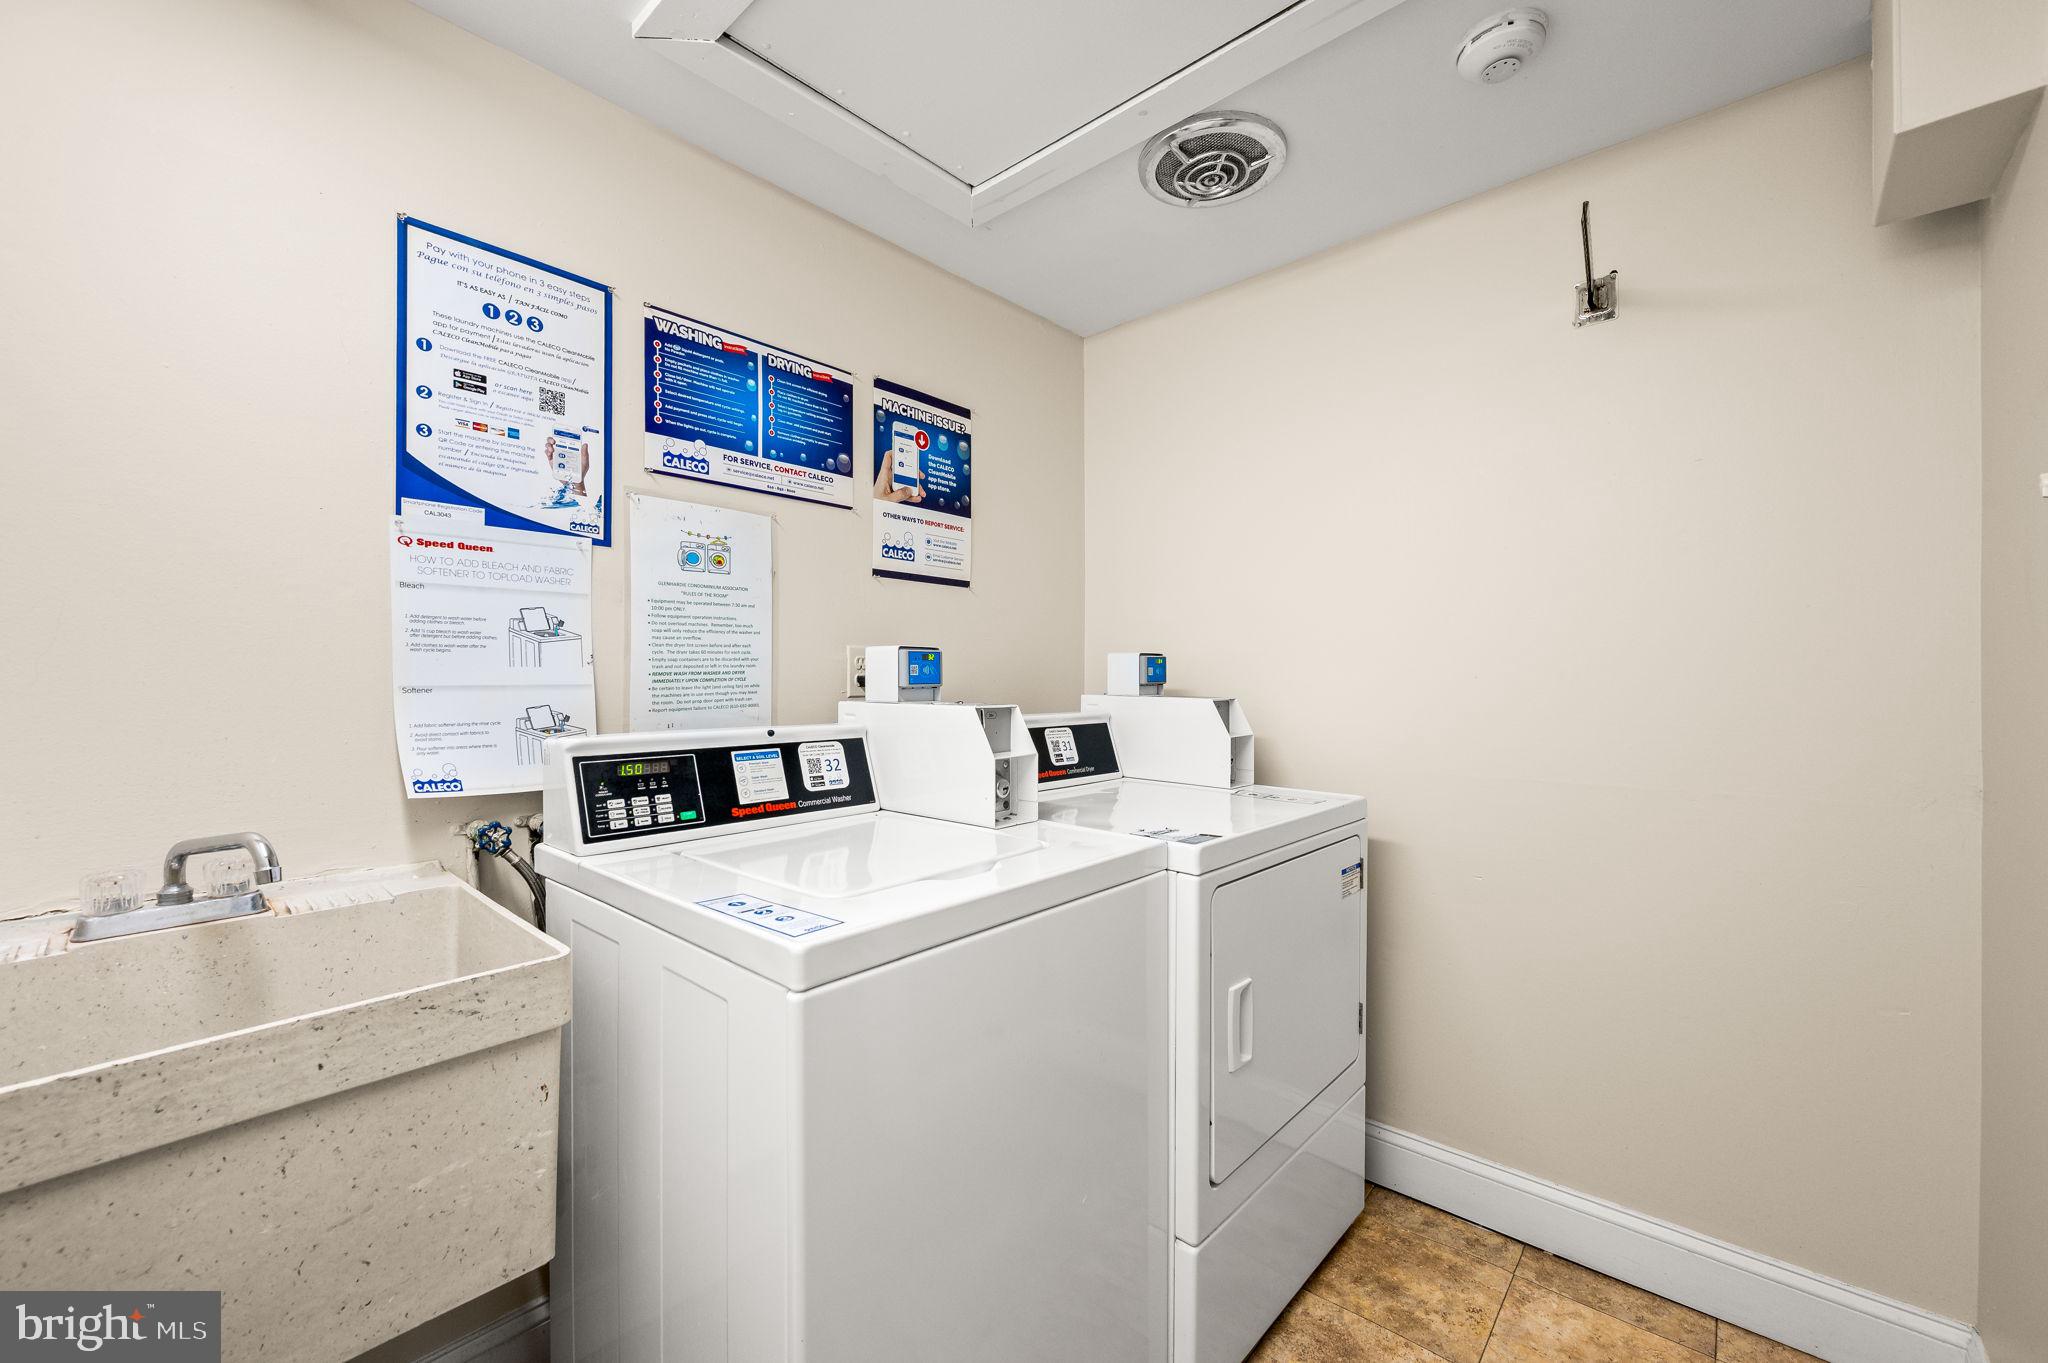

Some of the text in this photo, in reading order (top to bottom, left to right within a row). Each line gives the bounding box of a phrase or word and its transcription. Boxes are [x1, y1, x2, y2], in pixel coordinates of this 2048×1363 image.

[426, 241, 445, 255] Pay
[448, 249, 469, 262] with
[472, 257, 493, 272] your
[496, 265, 526, 282] phone
[529, 276, 537, 284] in
[547, 283, 567, 296] easy
[569, 289, 590, 303] steps
[416, 250, 448, 268] Pague
[451, 262, 468, 273] con
[523, 286, 534, 294] en
[544, 292, 573, 308] simples
[576, 303, 598, 315] pasos
[456, 280, 467, 288] IT'S
[480, 287, 495, 297] EASY
[515, 298, 529, 308] TAN
[551, 310, 568, 320] COMO
[487, 305, 539, 331] 1 2 3
[432, 310, 451, 321] These
[453, 316, 478, 329] laundry
[480, 324, 512, 338] machines
[537, 340, 560, 351] CALECO
[562, 347, 595, 361] CleanMobile
[433, 320, 447, 330] app
[460, 327, 490, 342] payment
[653, 317, 722, 350] WASHING
[421, 339, 426, 349] 1
[432, 328, 459, 341] CALECO
[499, 347, 514, 356] para
[439, 344, 471, 357] Download
[498, 359, 523, 371] CALECO
[525, 366, 559, 380] CleanMobile
[768, 354, 812, 378] DRYING
[420, 386, 428, 397] 2
[438, 390, 461, 402] Register
[469, 397, 481, 406] Sign
[504, 384, 518, 392] scan
[520, 387, 532, 396] here
[882, 398, 966, 434] MACHINE ISSUE?
[420, 425, 428, 436] 3
[465, 433, 490, 444] machine
[500, 440, 525, 451] scanning
[664, 456, 707, 473] CALECO
[928, 454, 951, 464] Download
[937, 463, 954, 472] CALECO
[723, 454, 833, 483] FOR SERVICE, CONTACT CALECO
[928, 469, 956, 479] CleanMobile
[402, 498, 436, 508] Smartphone
[438, 503, 466, 513] Registration
[424, 508, 451, 519] CAL3043
[571, 524, 599, 534] CALECO
[883, 512, 900, 520] OTHER
[902, 515, 916, 524] WAYS
[925, 520, 943, 529] REPORT
[944, 523, 965, 533] SERVICE:
[416, 538, 493, 552] Speed Queen
[883, 548, 914, 561] CALECO
[410, 555, 574, 576] HOW TO ADD BLEACH AND FABRIC
[417, 566, 571, 585] SOFTENER TO TOPLOAD WASHER
[1062, 741, 1072, 751] 31
[824, 759, 841, 772] 32
[414, 783, 460, 793] CALECO
[732, 795, 851, 817] Speed Queen Commercial Washer
